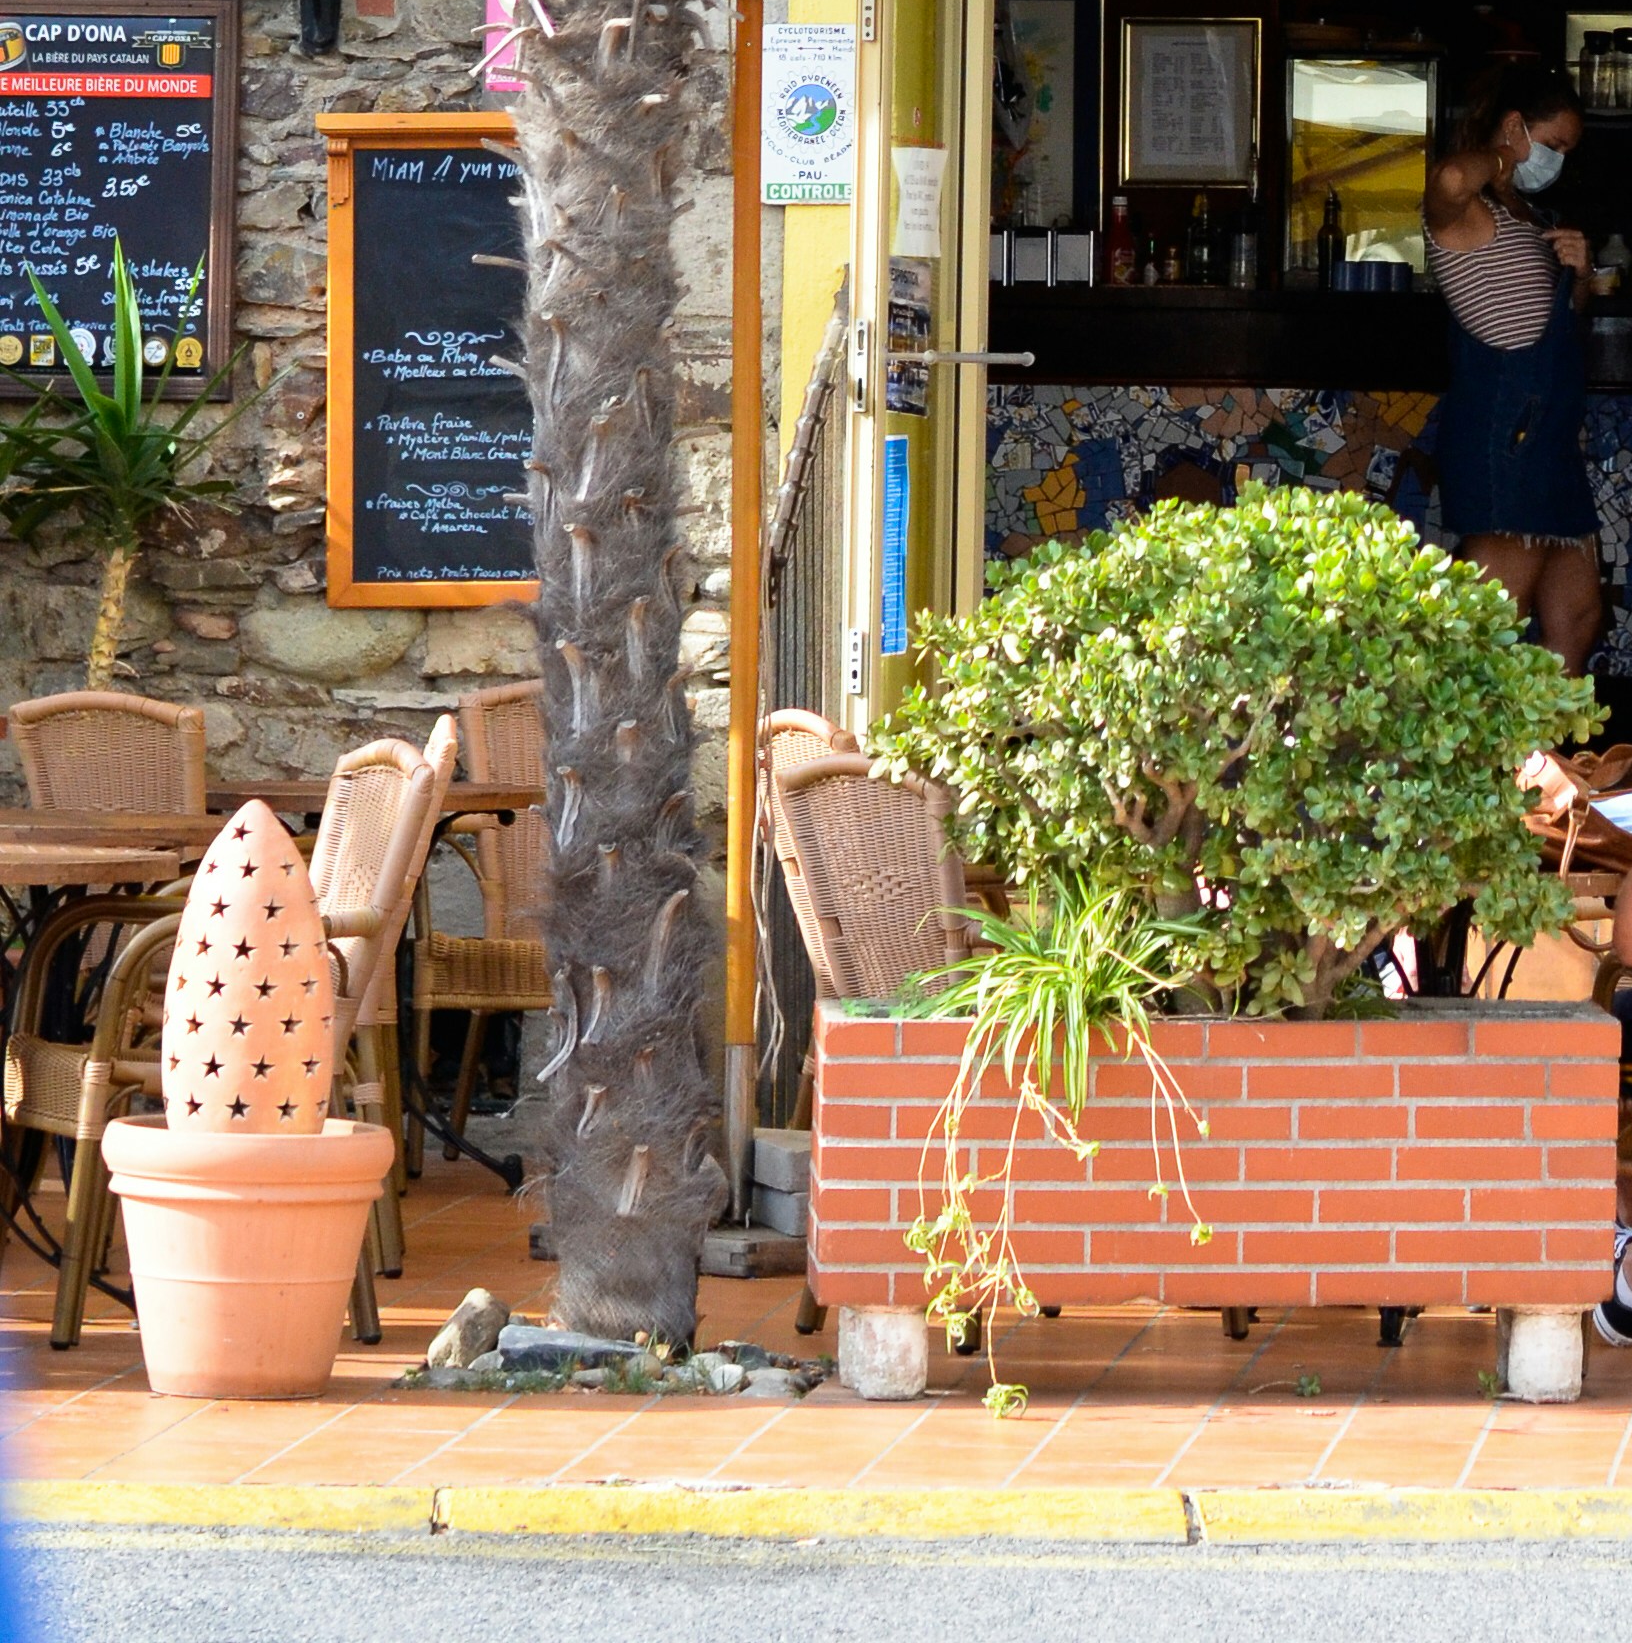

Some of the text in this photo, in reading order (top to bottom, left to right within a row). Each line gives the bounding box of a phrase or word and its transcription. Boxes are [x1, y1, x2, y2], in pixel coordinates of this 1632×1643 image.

[25, 24, 127, 42] CAP D'ONA
[778, 27, 846, 35] CYCLOTOURISME
[32, 51, 150, 64] LA BIÈRE DU PAYS CATALAN
[11, 76, 198, 93] MEILLEURE BIÈRE DU MONDE
[110, 121, 164, 139] Blanche
[459, 162, 491, 183] YUM
[39, 189, 96, 207] Catalana
[65, 208, 89, 221] Bio
[92, 223, 117, 238] Bio
[30, 240, 70, 254] Cola
[142, 258, 189, 277] shakes
[370, 348, 411, 364] Baba
[394, 366, 446, 380] Moelleux
[377, 415, 426, 431] Pavlova
[398, 433, 450, 449] Mystère
[413, 447, 449, 461] Mont
[450, 447, 485, 460] Blanc
[425, 498, 464, 510] Melba
[410, 509, 439, 523] Café
[460, 506, 509, 520] chocolat
[432, 522, 488, 533] Amarena
[377, 567, 401, 579] Prix
